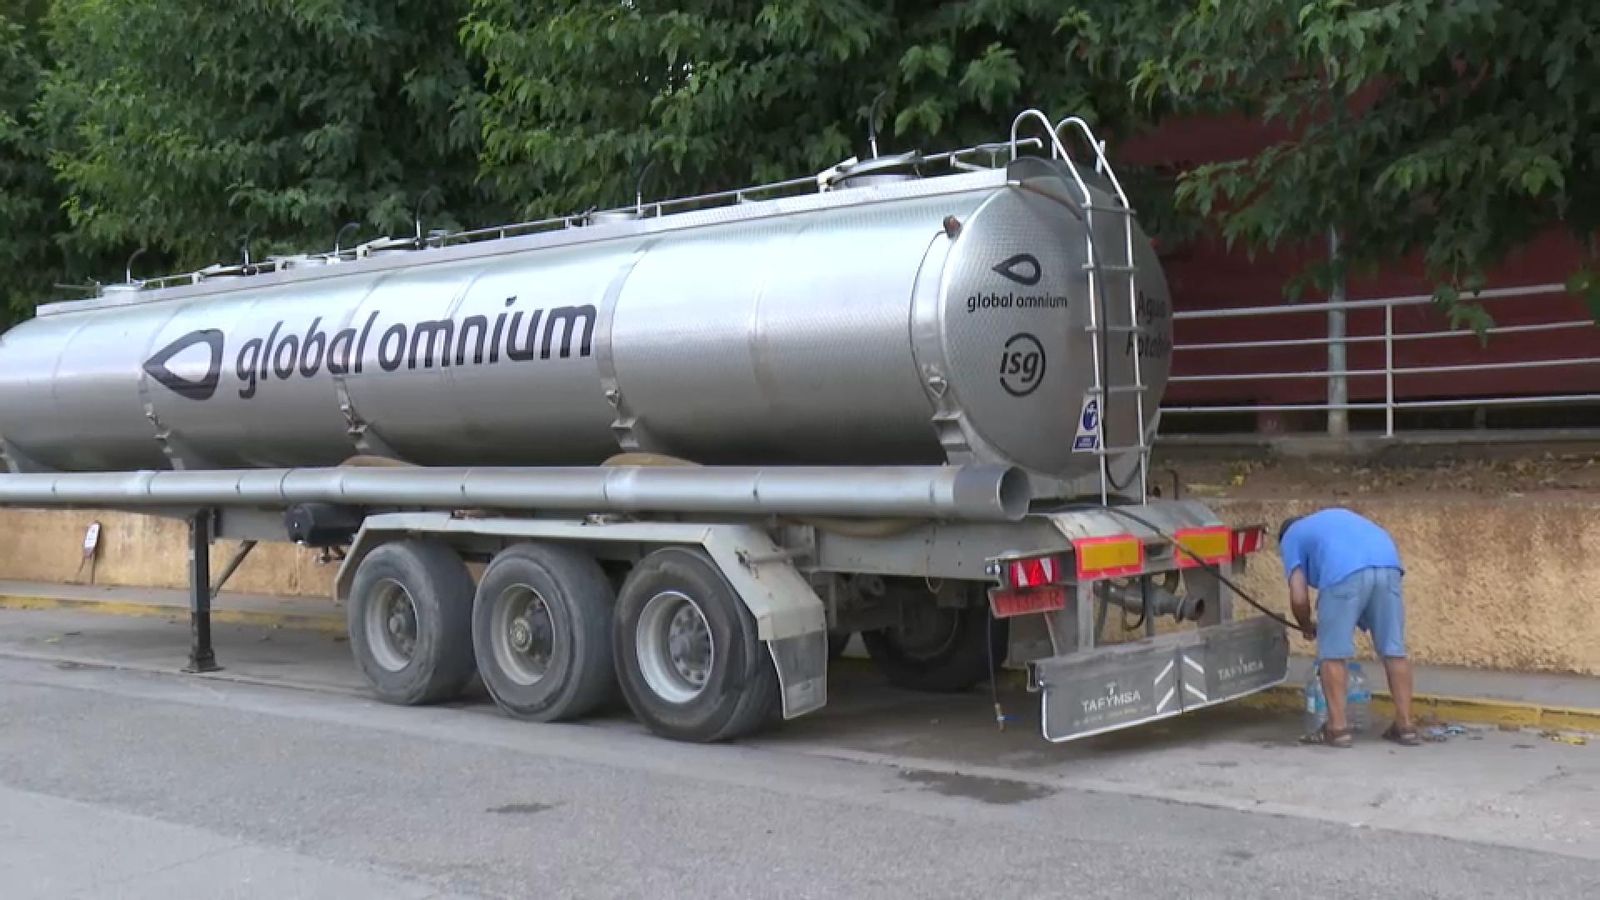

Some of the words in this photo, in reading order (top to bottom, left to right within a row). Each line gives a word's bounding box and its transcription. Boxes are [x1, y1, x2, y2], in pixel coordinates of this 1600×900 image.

[967, 292, 1013, 313] global
[1016, 292, 1068, 309] omnium
[236, 310, 380, 399] global
[377, 295, 598, 373] omnium
[1000, 350, 1039, 383] isg
[1081, 690, 1141, 713] TAFYMSA
